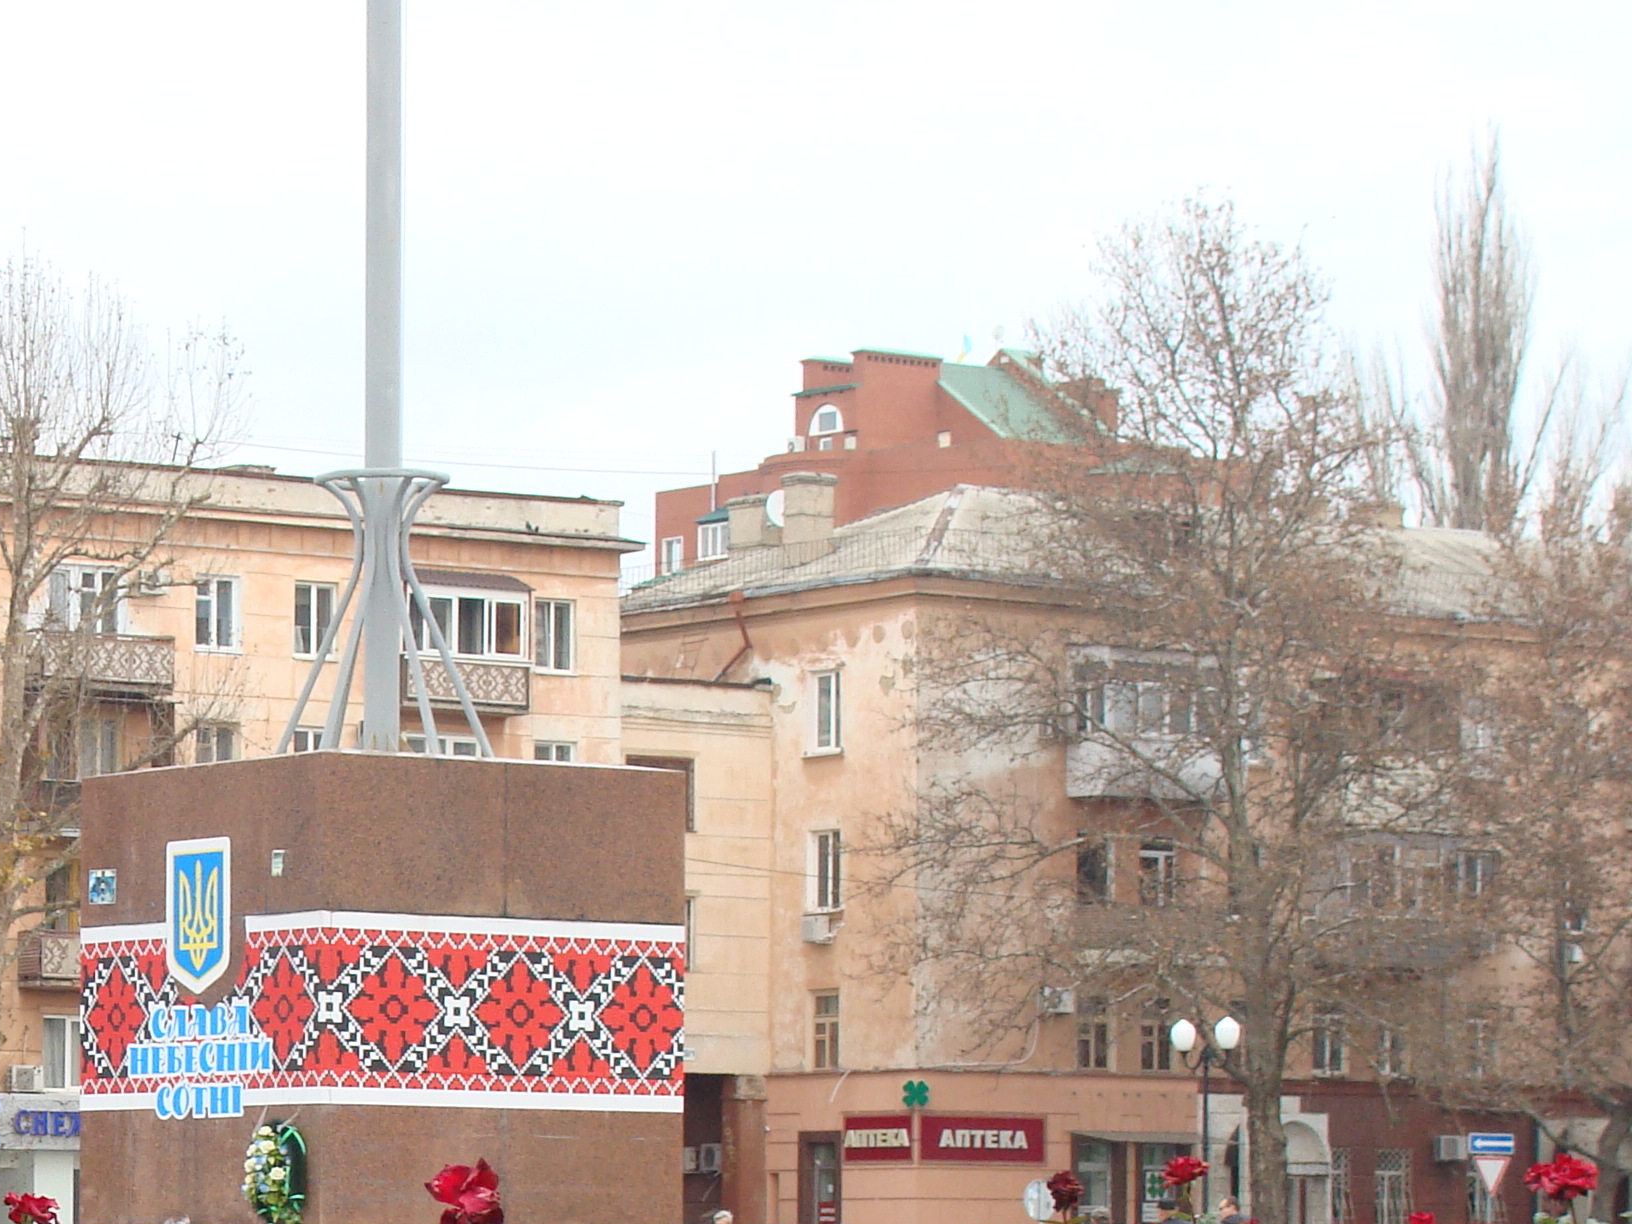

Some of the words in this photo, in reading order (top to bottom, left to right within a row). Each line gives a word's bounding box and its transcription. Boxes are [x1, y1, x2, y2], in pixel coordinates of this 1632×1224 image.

[151, 1005, 248, 1039] СЛАВА
[129, 1038, 271, 1075] НЕБЕСНІЙ
[156, 1085, 242, 1116] СОТНІ
[843, 1128, 910, 1148] АПТЕКА
[938, 1128, 1029, 1149] АПТЕКА
